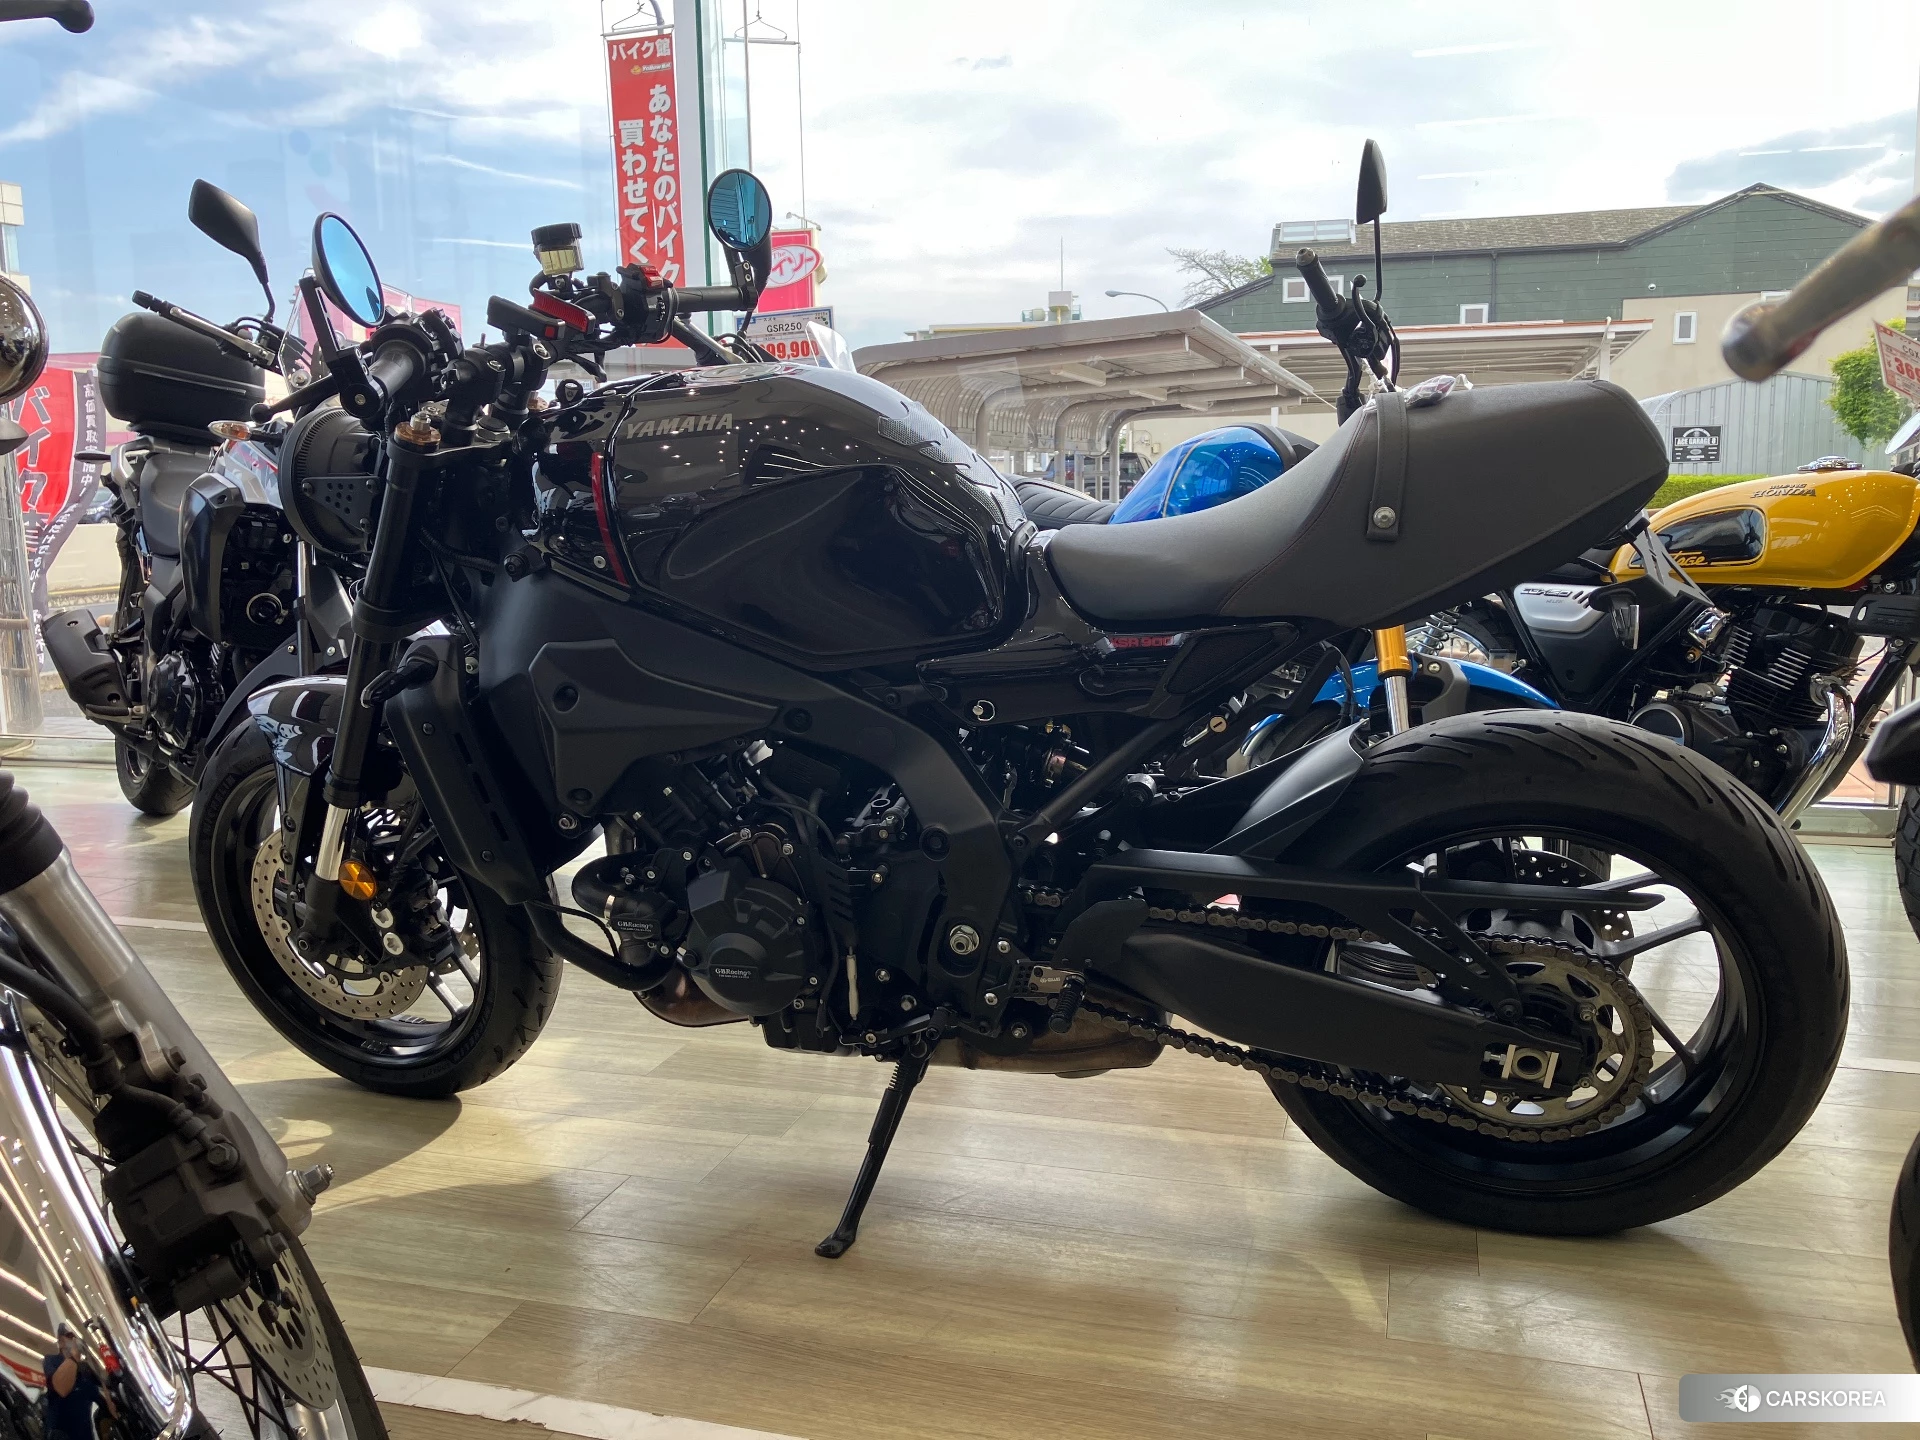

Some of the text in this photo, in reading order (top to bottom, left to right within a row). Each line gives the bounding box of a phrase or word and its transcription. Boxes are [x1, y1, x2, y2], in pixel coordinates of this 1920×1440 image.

[611, 37, 671, 61] バイク館
[618, 119, 649, 264] 買わせてく
[648, 83, 681, 284] あなたのバイク
[766, 322, 803, 333] GSR250
[760, 339, 819, 360] 99,900
[627, 413, 733, 439] YAMAHA
[1750, 489, 1816, 499] HONDA
